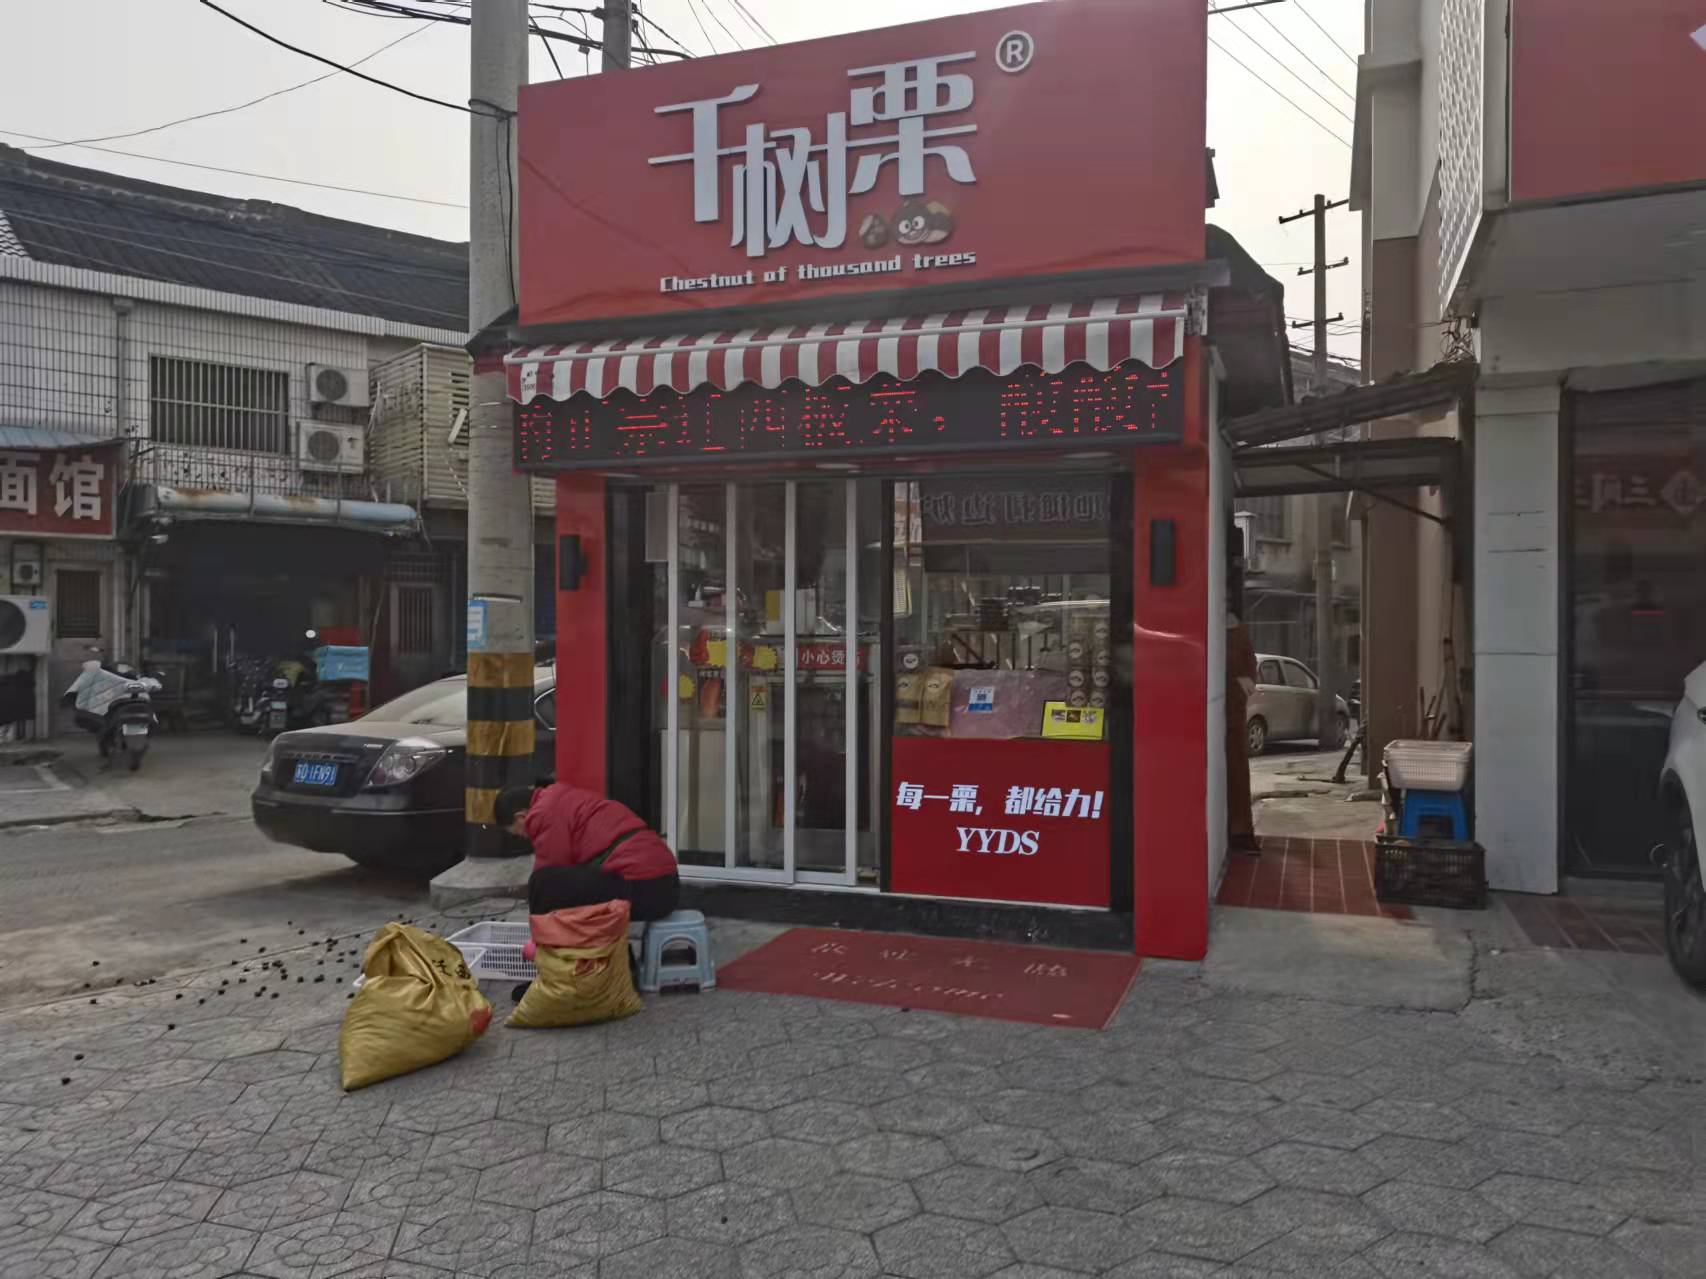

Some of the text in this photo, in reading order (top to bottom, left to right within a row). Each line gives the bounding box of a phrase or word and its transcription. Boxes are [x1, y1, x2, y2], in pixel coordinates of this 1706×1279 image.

[648, 51, 977, 257] 千树栗
[660, 252, 977, 292] Chestnut of thousand trees
[0, 452, 105, 521] 面馆
[800, 650, 861, 666] 小心烫
[956, 827, 1040, 856] YYDS
